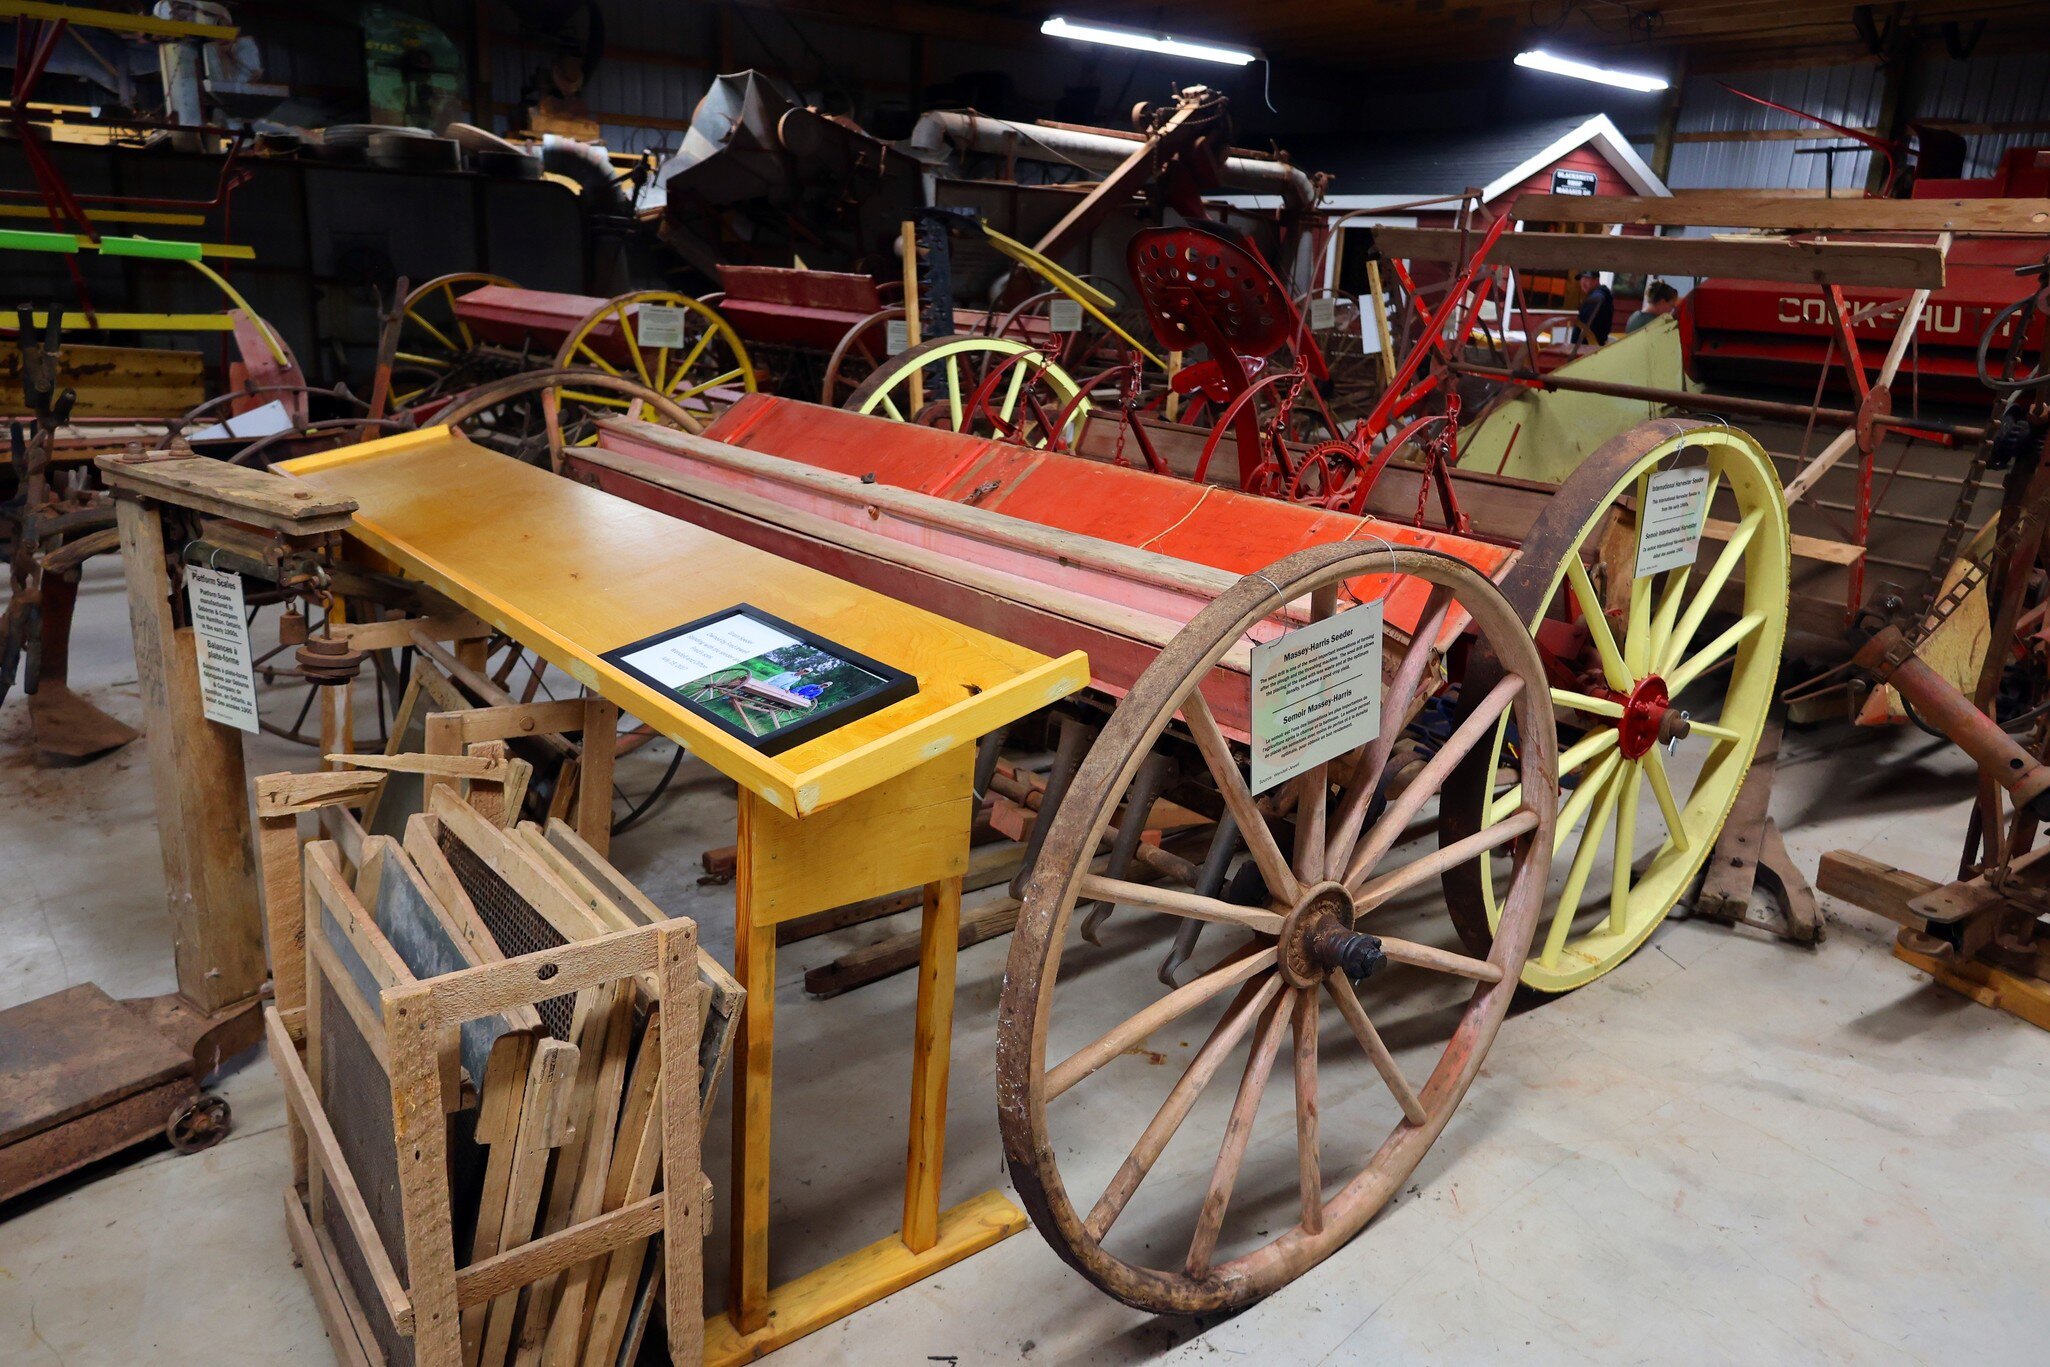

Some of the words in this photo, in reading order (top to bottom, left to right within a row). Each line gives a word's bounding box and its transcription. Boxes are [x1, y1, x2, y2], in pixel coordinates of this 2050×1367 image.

[191, 572, 216, 585] Platform
[216, 578, 236, 590] Scales
[207, 640, 233, 654] Balances
[208, 651, 240, 666] plate-forme
[1284, 638, 1330, 662] Massey-Harris
[1331, 629, 1353, 643] Seeder
[1318, 649, 1336, 660] important
[1336, 641, 1356, 652] innovations
[1361, 634, 1374, 642] farming
[1273, 684, 1287, 694] placing
[1354, 650, 1369, 659] optimum
[1277, 676, 1290, 685] plough
[1304, 662, 1322, 673] threshing
[1322, 656, 1338, 665] machine.
[1286, 686, 1300, 695] density,
[1305, 678, 1319, 687] achieve
[1323, 672, 1332, 680] good
[1271, 733, 1284, 741] semoir
[1307, 714, 1328, 725] innovations
[1342, 698, 1363, 710] importantes
[1283, 709, 1306, 724] Semoir
[1308, 689, 1352, 713] Massey-Harris
[1262, 740, 1284, 752] l'agriculture
[1300, 726, 1314, 735] charrue
[1323, 716, 1339, 725] batteuse.
[1346, 707, 1357, 715] semoir
[1358, 701, 1370, 710] permet
